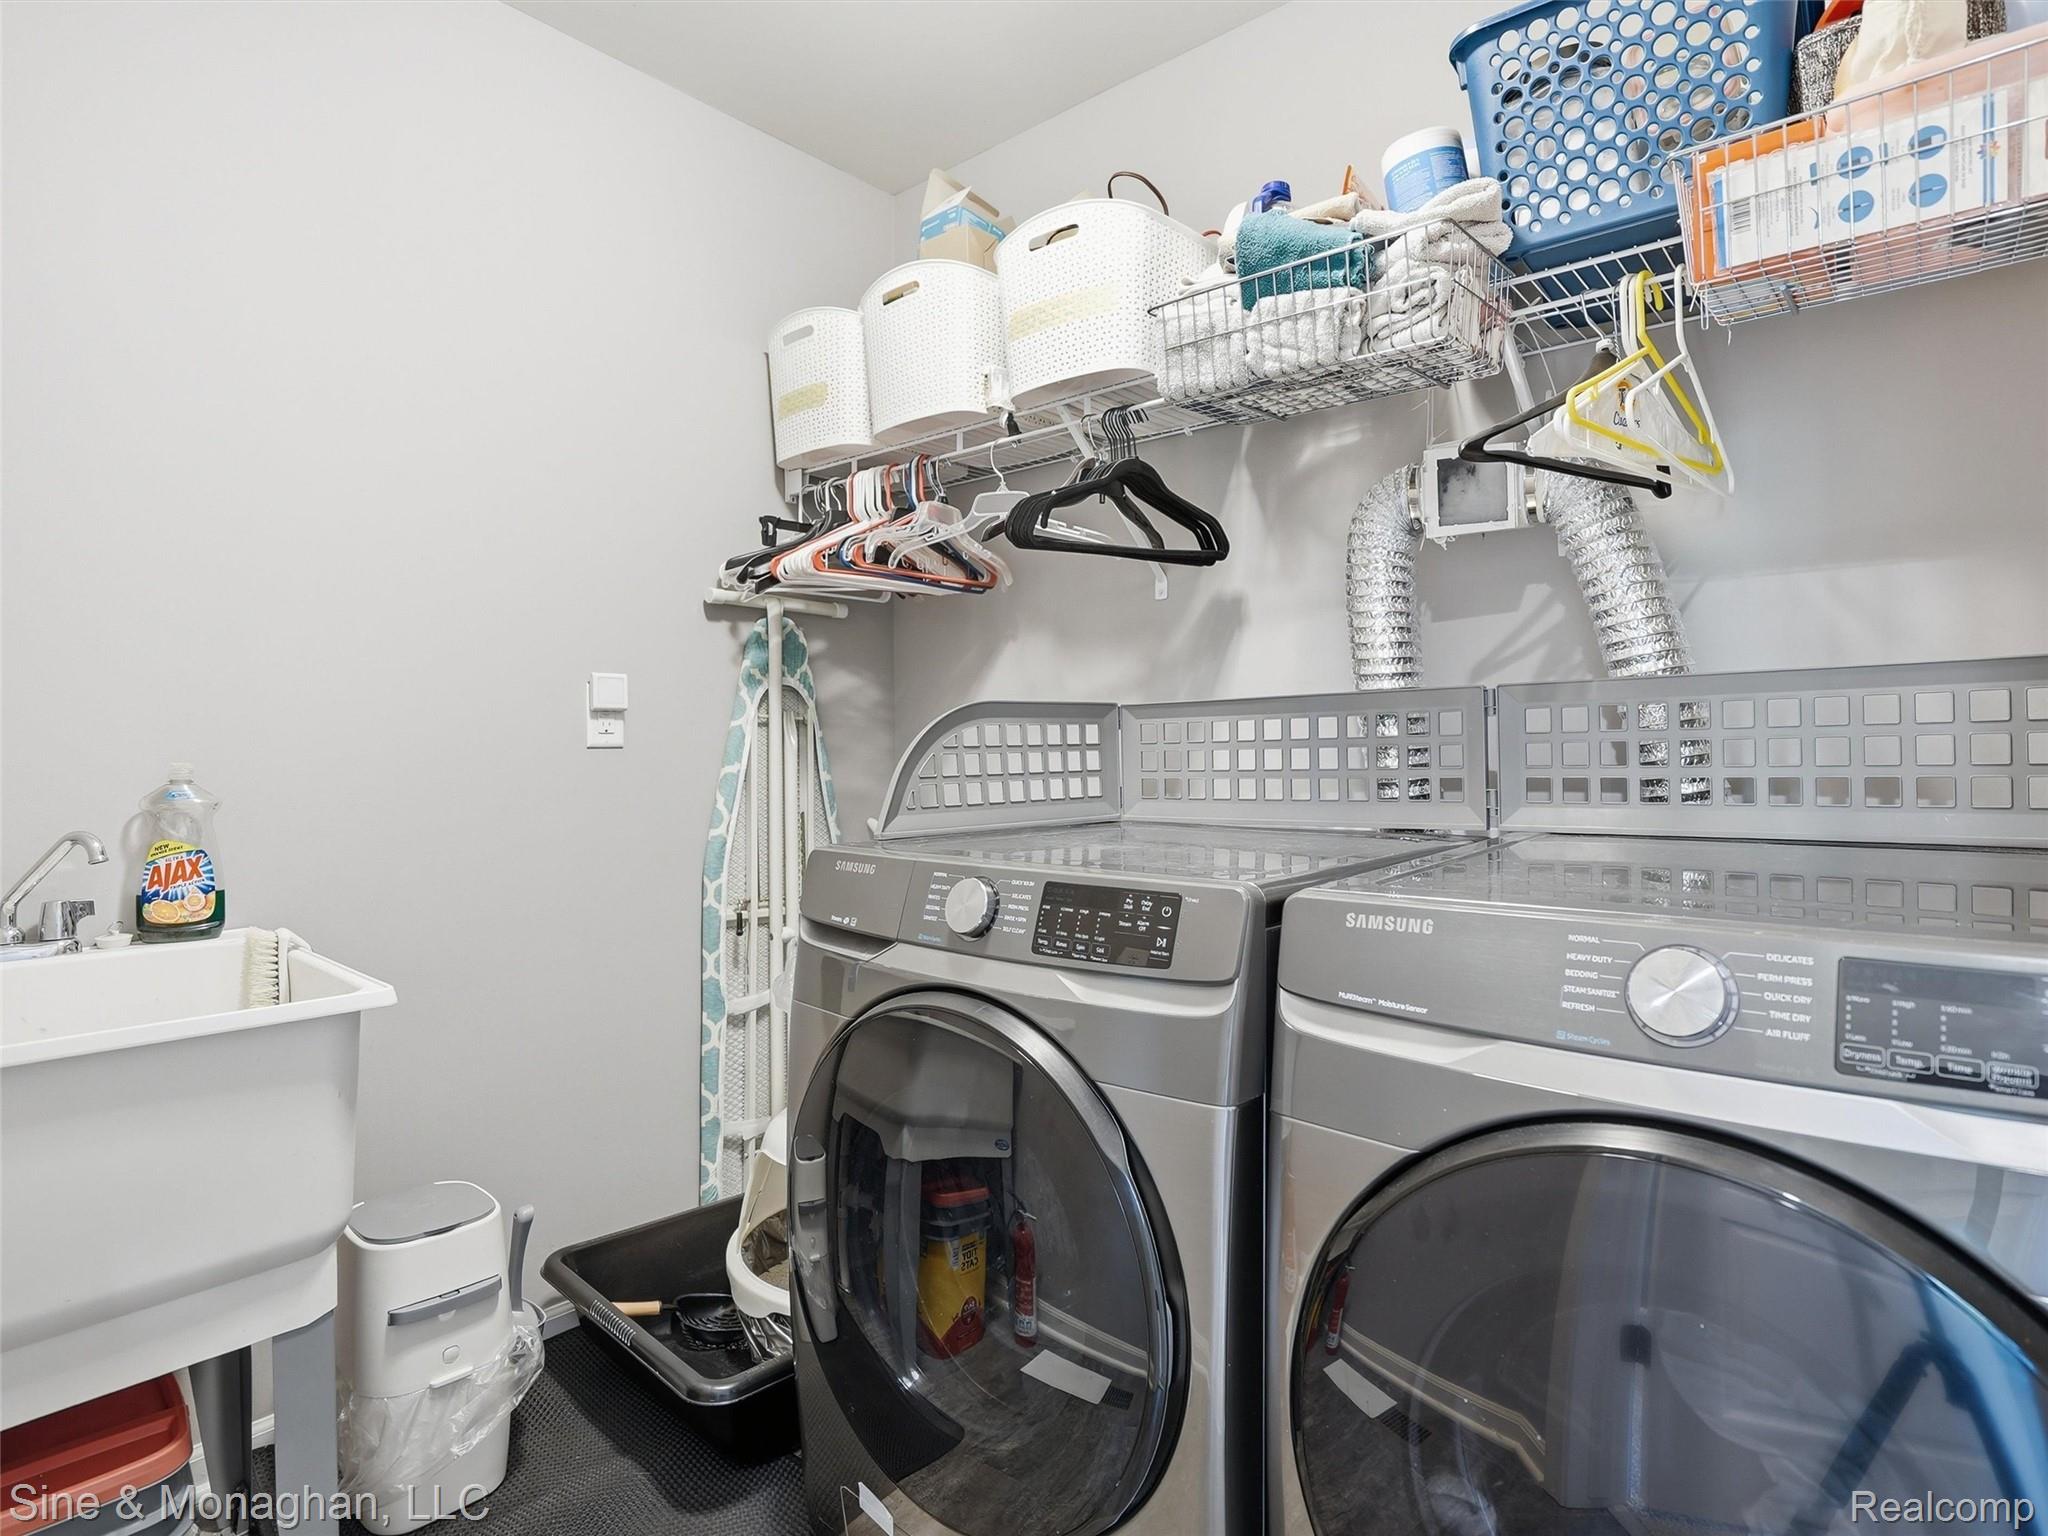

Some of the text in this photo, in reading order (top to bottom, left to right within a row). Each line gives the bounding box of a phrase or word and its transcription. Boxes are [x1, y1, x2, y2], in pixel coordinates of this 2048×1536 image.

[154, 843, 170, 851] NEW
[147, 855, 204, 892] AJAX
[835, 860, 877, 875] SAMSUNG
[1345, 912, 1434, 935] SAMSUNG
[1567, 934, 1600, 944] NORMAL
[1566, 952, 1613, 964] HEAVY DUTY
[1766, 952, 1815, 966] DELICATES
[1565, 968, 1599, 979] BEDDING
[1757, 972, 1813, 987] PERM PRESS
[1764, 991, 1812, 1005] QUICK DRY
[1378, 999, 1405, 1010] Moisture
[1405, 1003, 1429, 1014] Sensor
[1562, 1001, 1596, 1012] REFRESH
[1768, 1010, 1812, 1023] TIME DRY
[1765, 1028, 1811, 1041] AIR FLUFF
[1844, 1048, 1882, 1062] Dryness
[1947, 1061, 1973, 1074] Time
